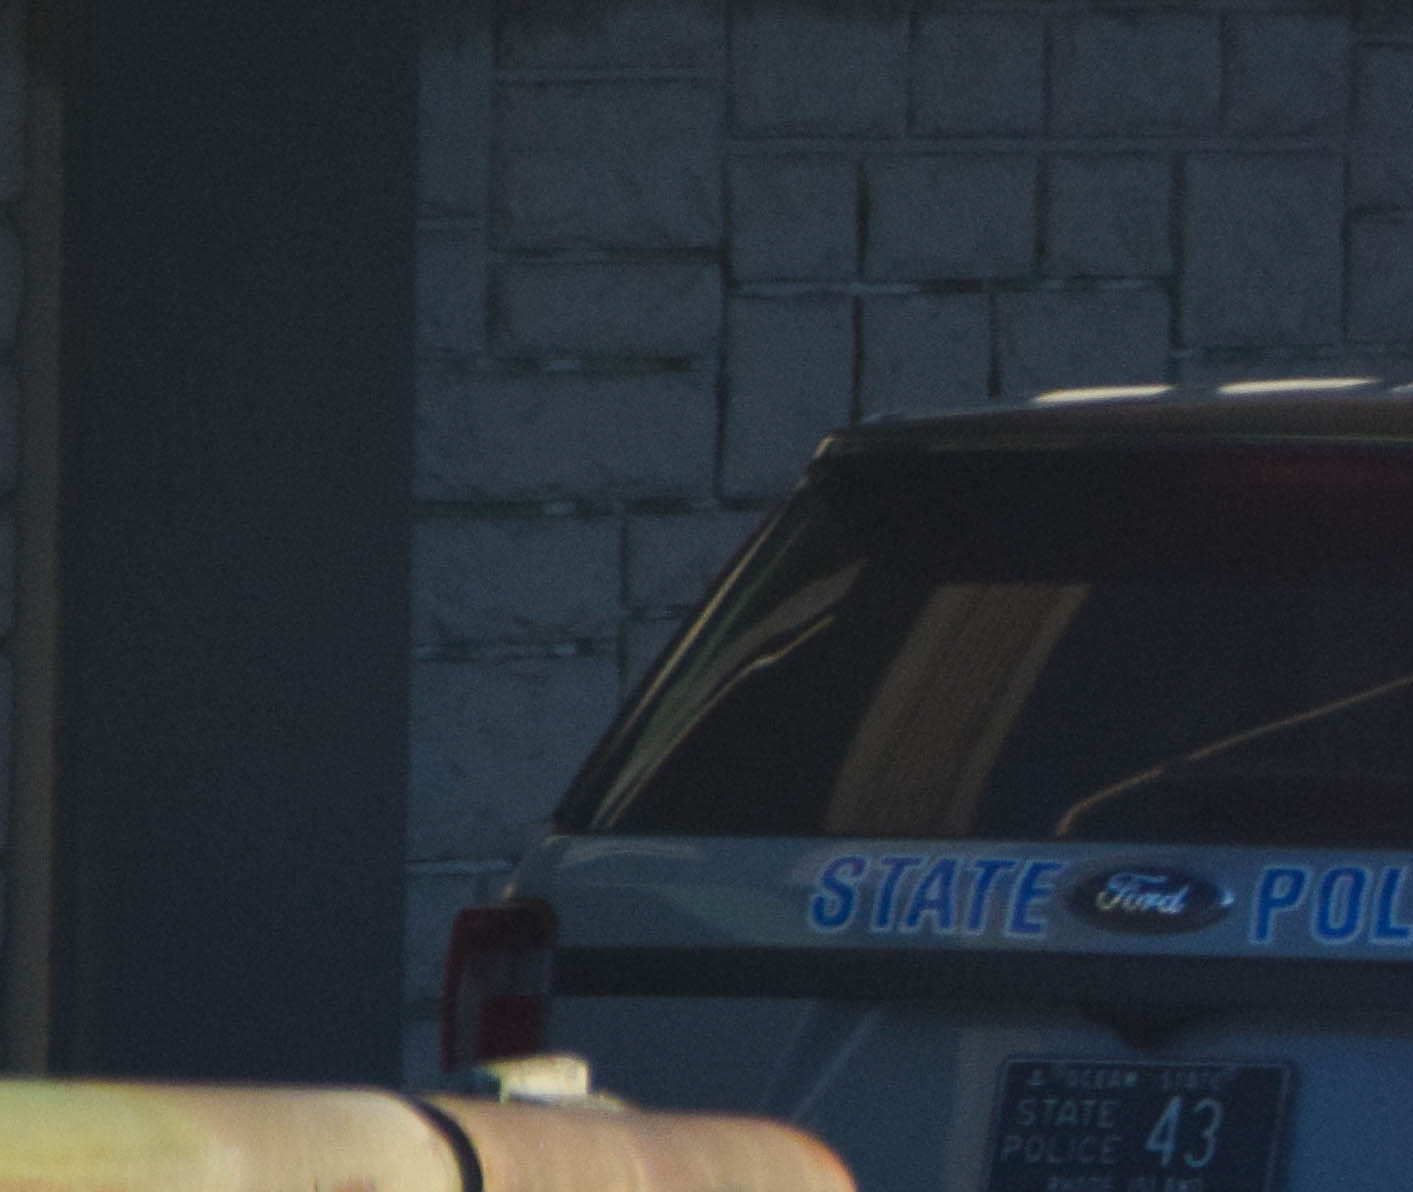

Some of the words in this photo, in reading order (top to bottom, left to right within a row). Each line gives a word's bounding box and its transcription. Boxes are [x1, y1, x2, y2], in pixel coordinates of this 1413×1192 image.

[808, 854, 1068, 940] STATE
[1096, 872, 1190, 914] Ford
[1017, 1098, 1118, 1129] STATE
[1145, 1095, 1224, 1169] 43
[1001, 1135, 1121, 1164] POLICE
